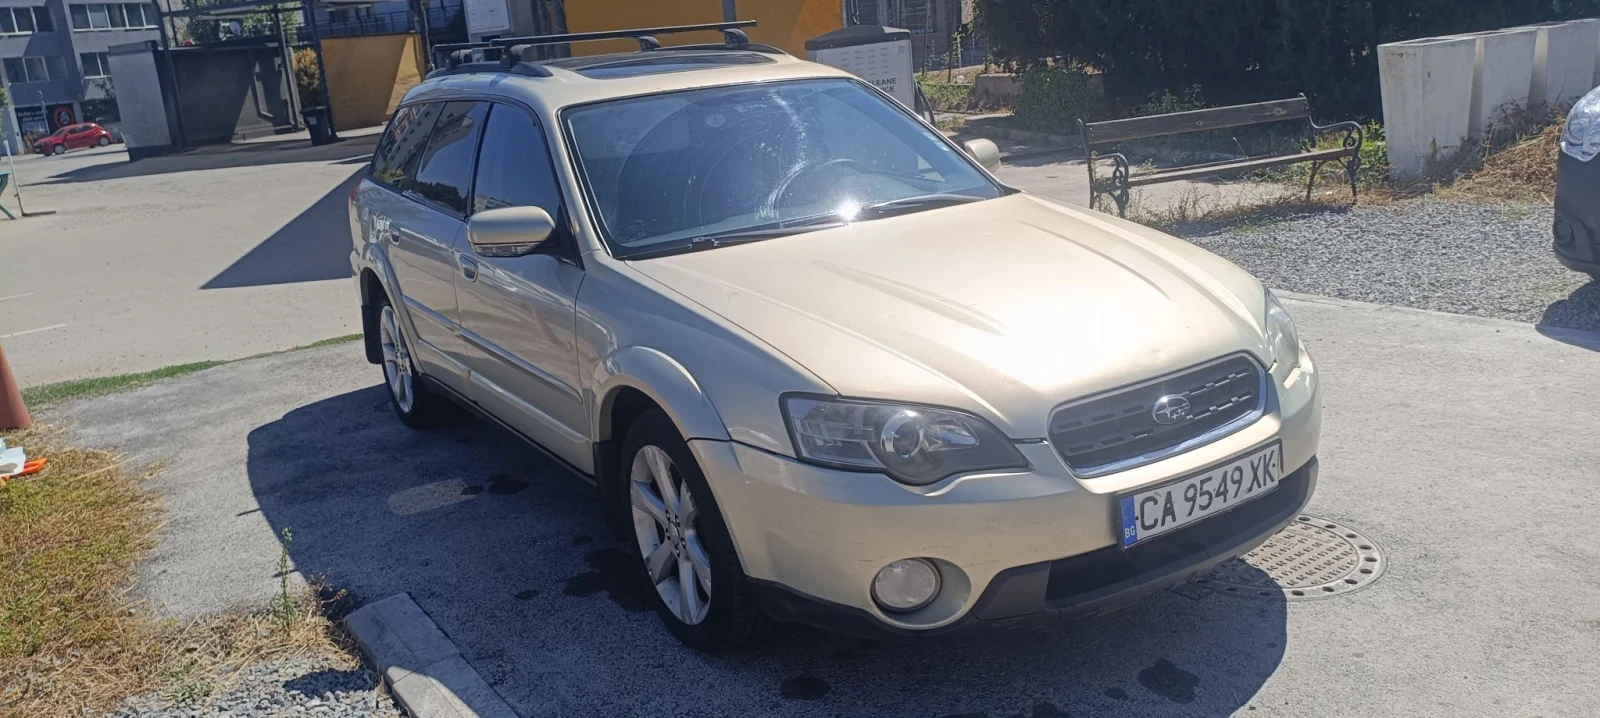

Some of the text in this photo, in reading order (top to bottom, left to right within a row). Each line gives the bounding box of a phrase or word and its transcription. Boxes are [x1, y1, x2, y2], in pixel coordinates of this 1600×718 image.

[1139, 450, 1276, 531] CA 9549 XK
[1124, 525, 1136, 539] BG
